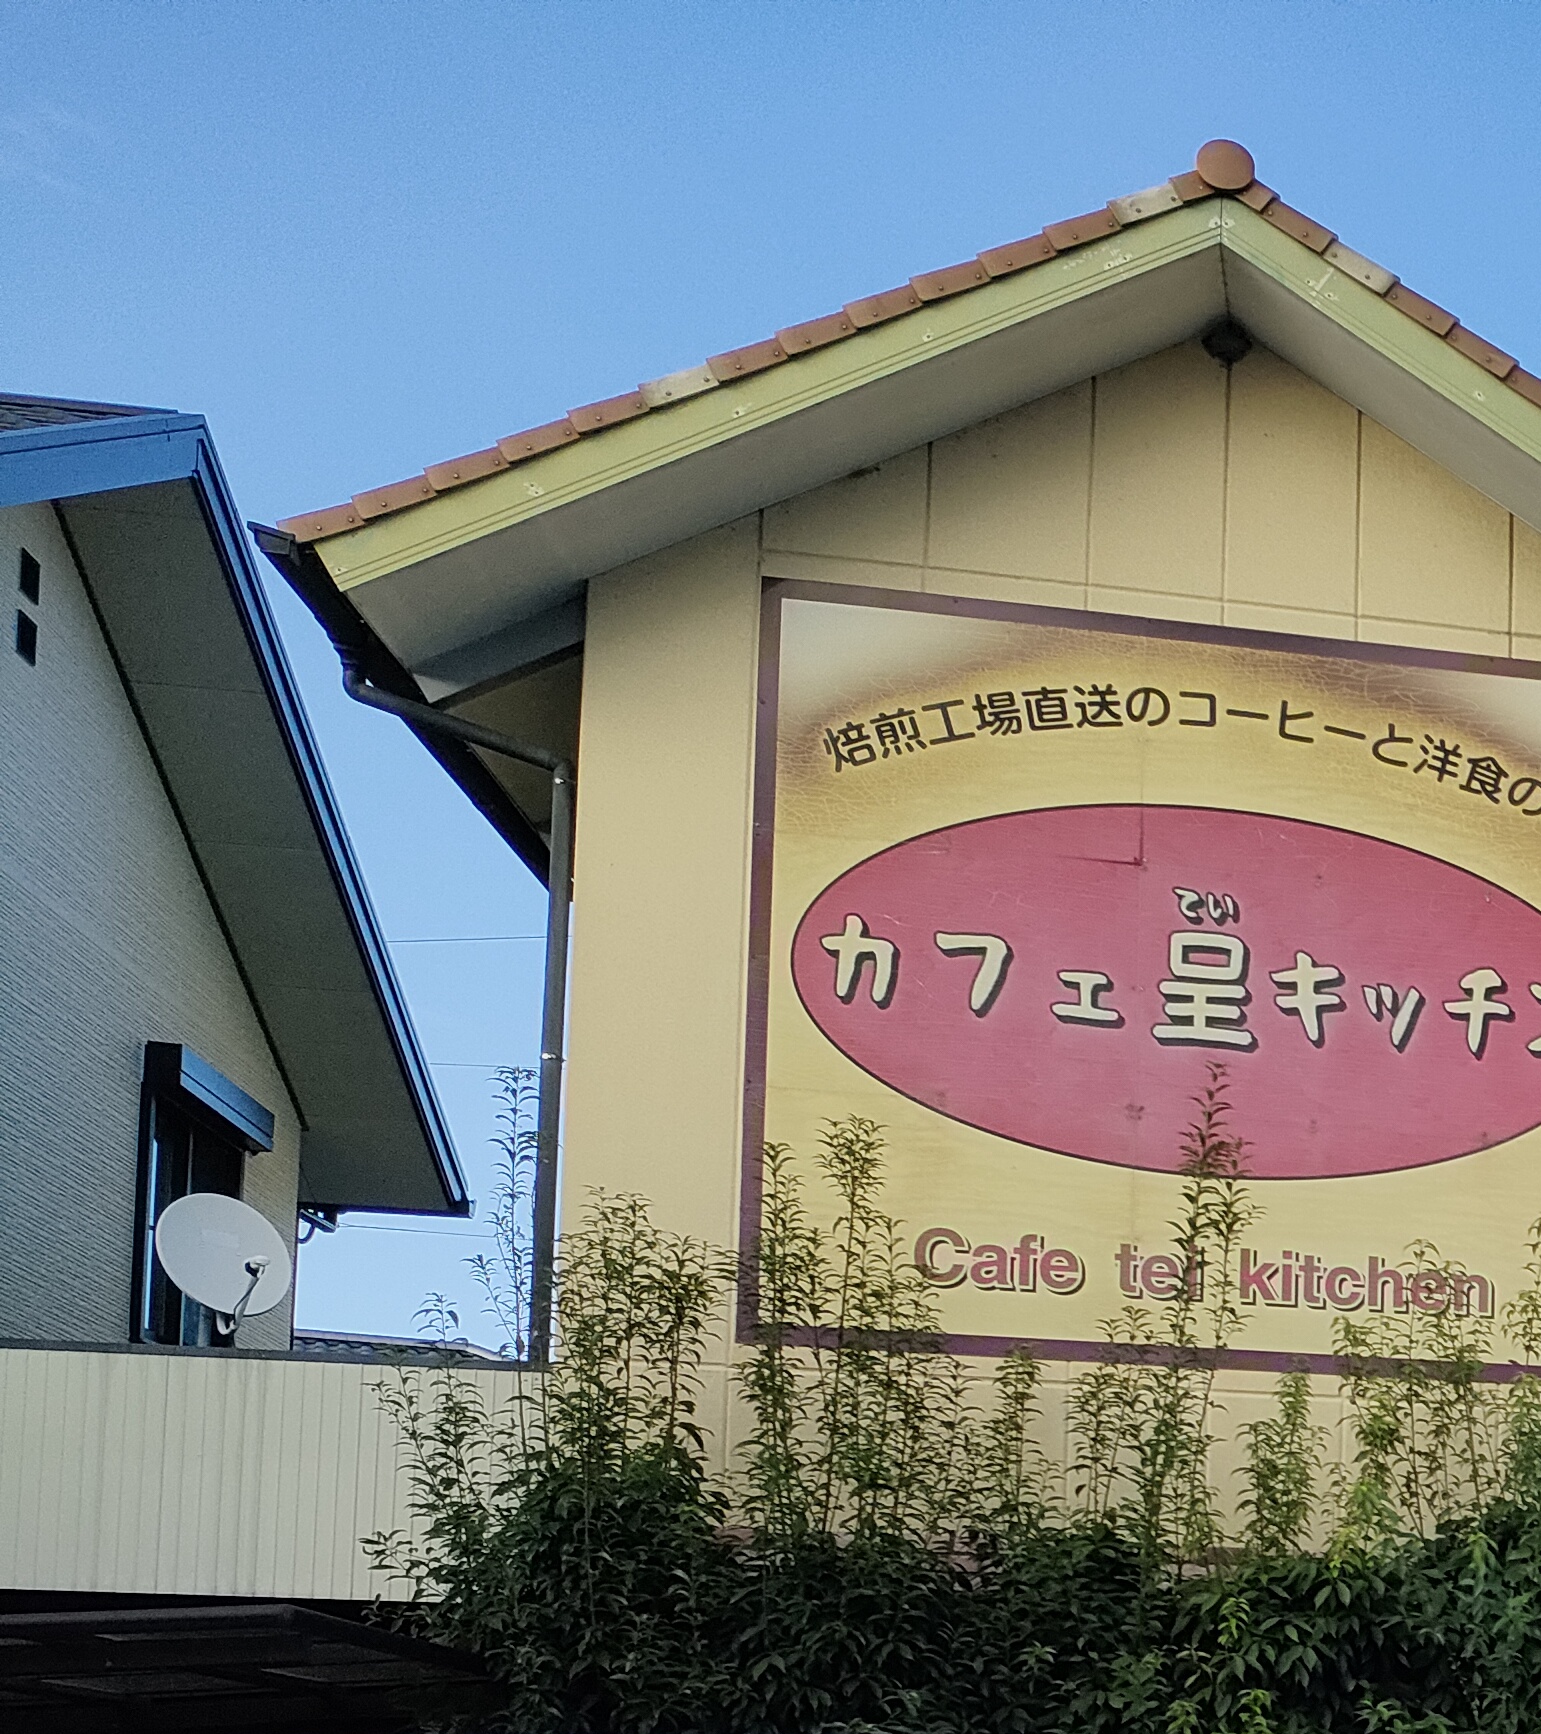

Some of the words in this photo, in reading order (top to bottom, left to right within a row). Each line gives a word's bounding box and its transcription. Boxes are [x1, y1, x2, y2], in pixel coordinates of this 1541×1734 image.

[1172, 885, 1242, 924] てい
[914, 1227, 1085, 1295] Cafe
[1240, 1248, 1495, 1318] kitchen
